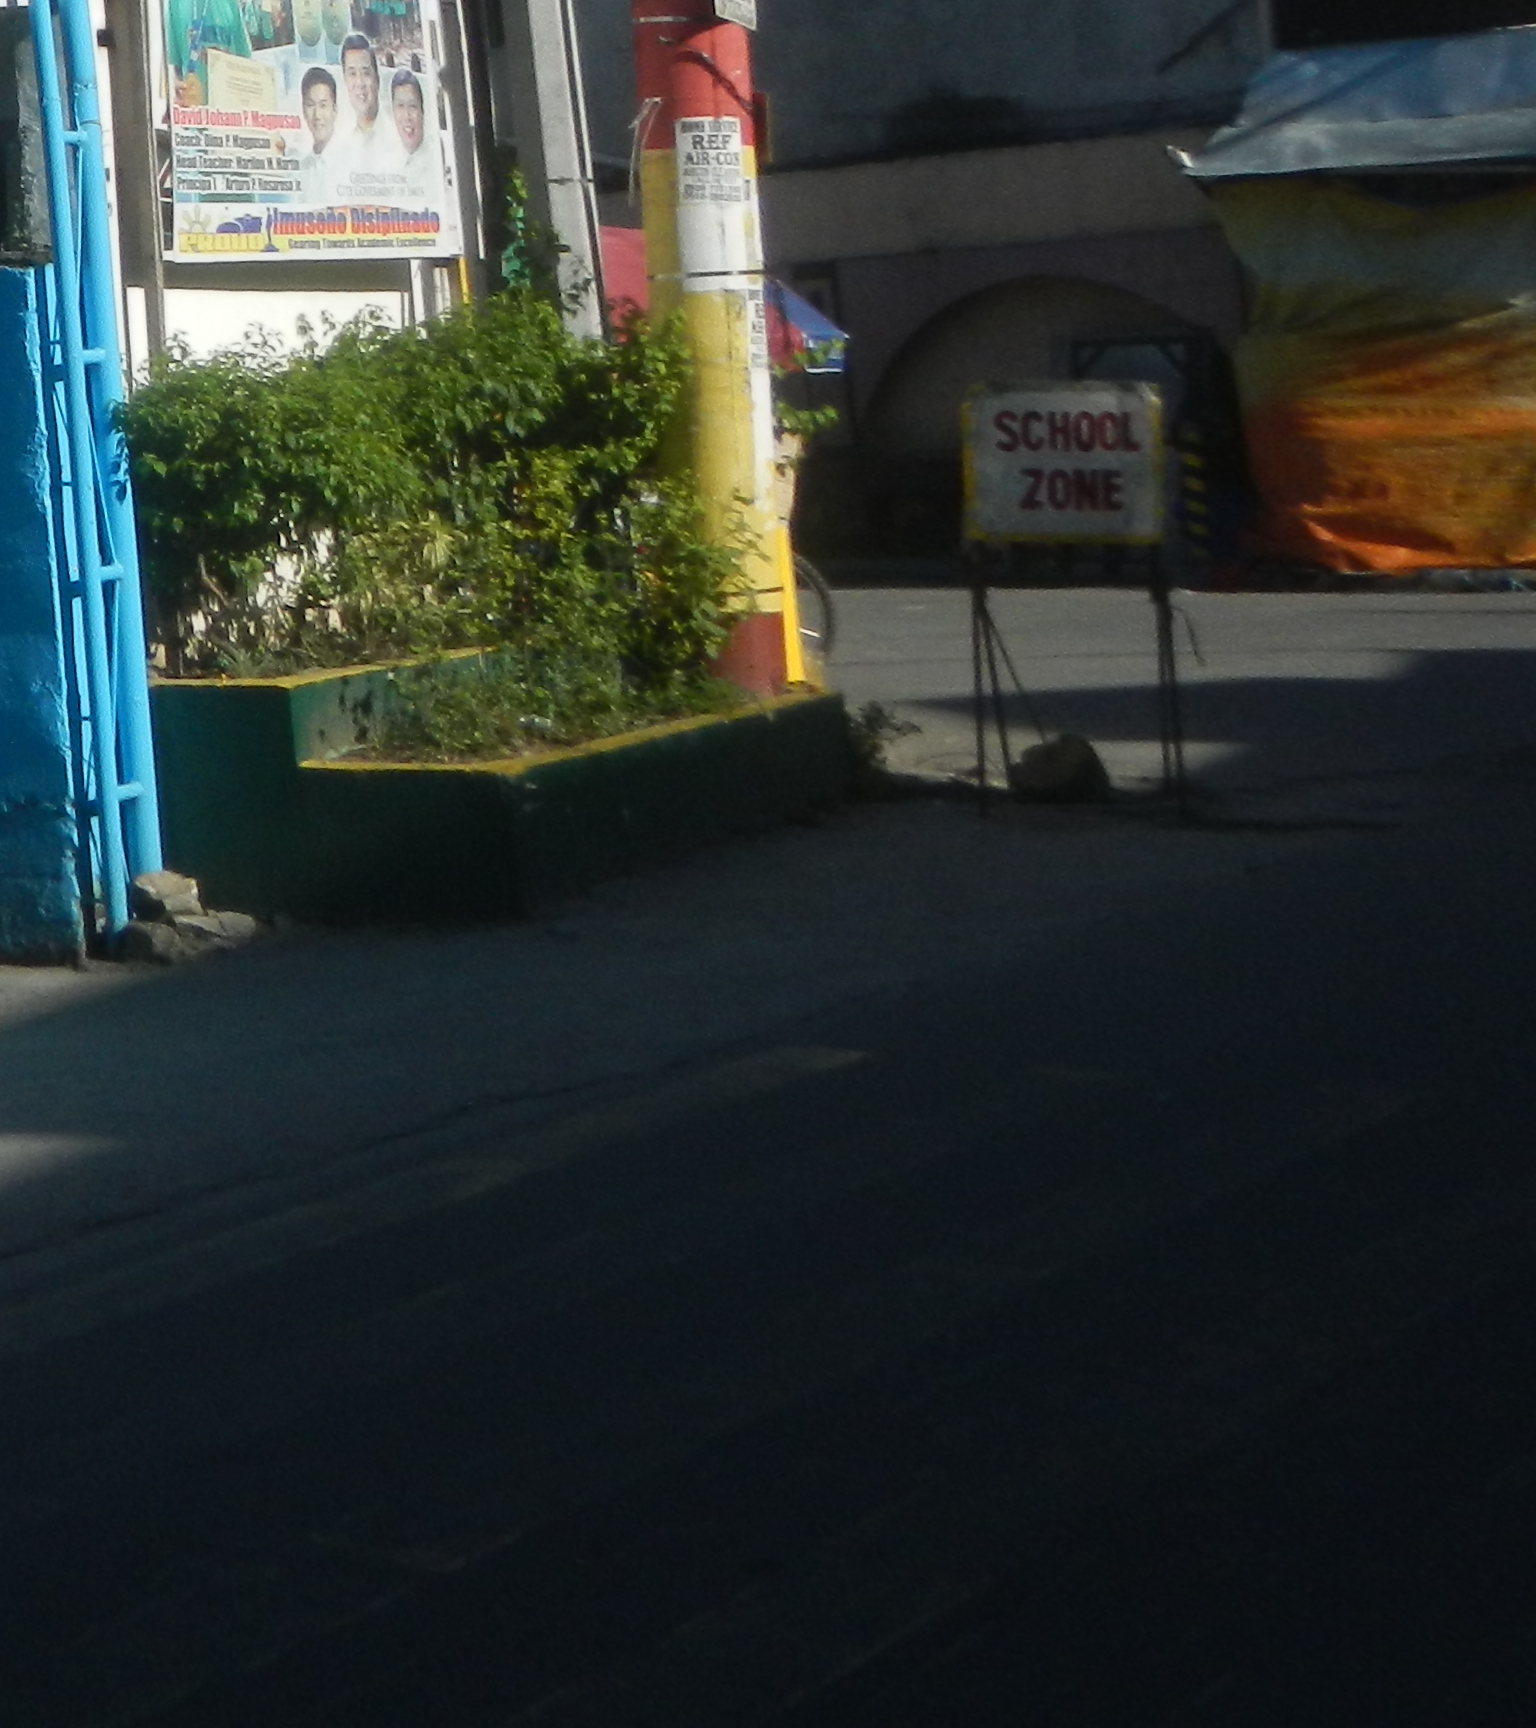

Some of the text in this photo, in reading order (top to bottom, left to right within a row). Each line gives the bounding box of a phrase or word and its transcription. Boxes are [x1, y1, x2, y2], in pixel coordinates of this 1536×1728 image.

[691, 134, 732, 150] REF
[993, 410, 1142, 453] SCHOOL
[1019, 468, 1125, 512] ZONE
